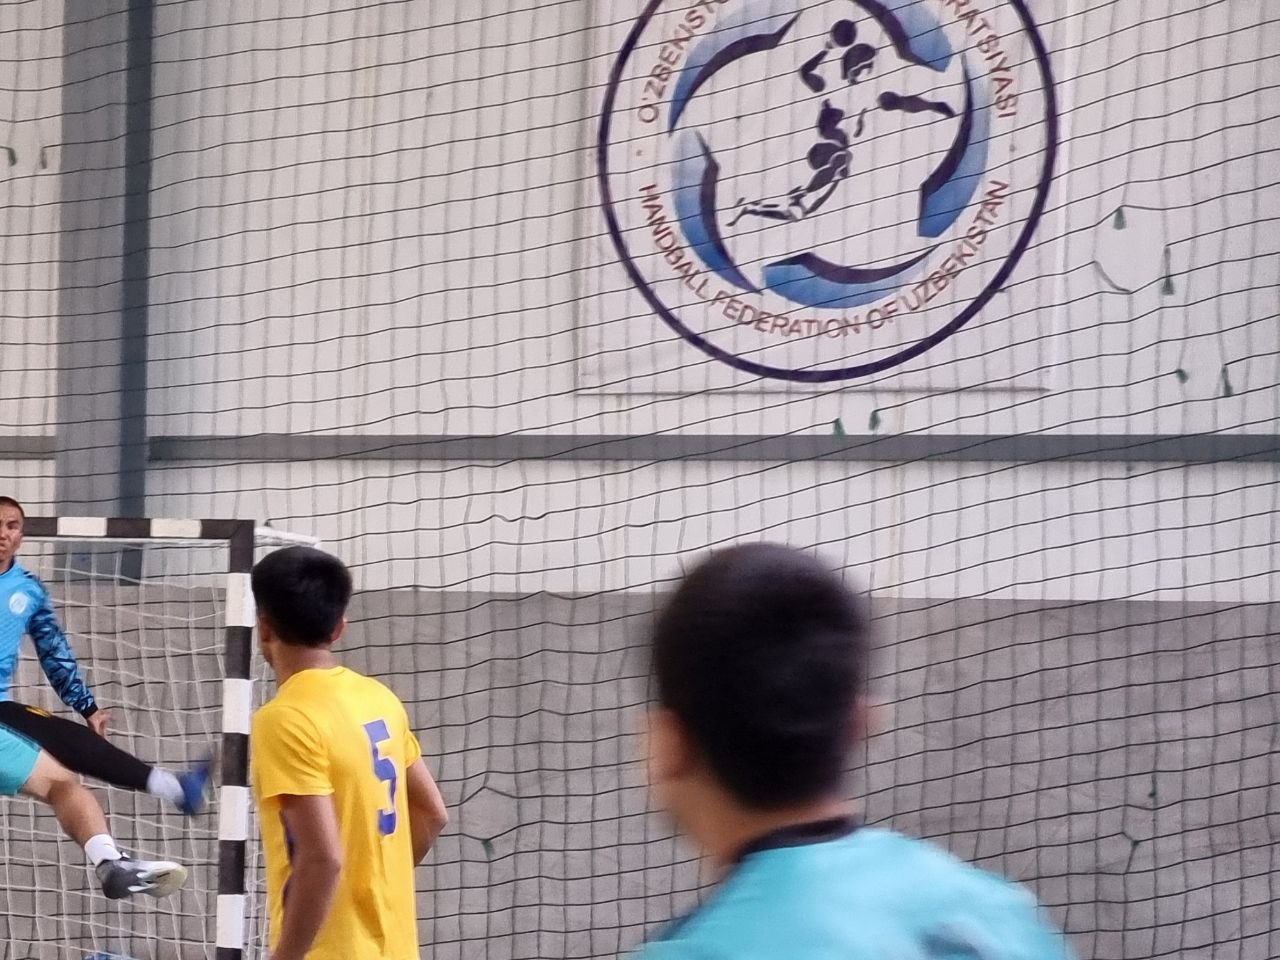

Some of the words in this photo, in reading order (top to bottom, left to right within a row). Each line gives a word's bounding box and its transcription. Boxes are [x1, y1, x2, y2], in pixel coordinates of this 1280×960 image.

[639, 184, 708, 301] HANDBALL
[710, 290, 860, 339] FEDERATION
[866, 299, 898, 329] OF
[898, 180, 1009, 312] UZBEKISTAN
[361, 718, 397, 837] 5
